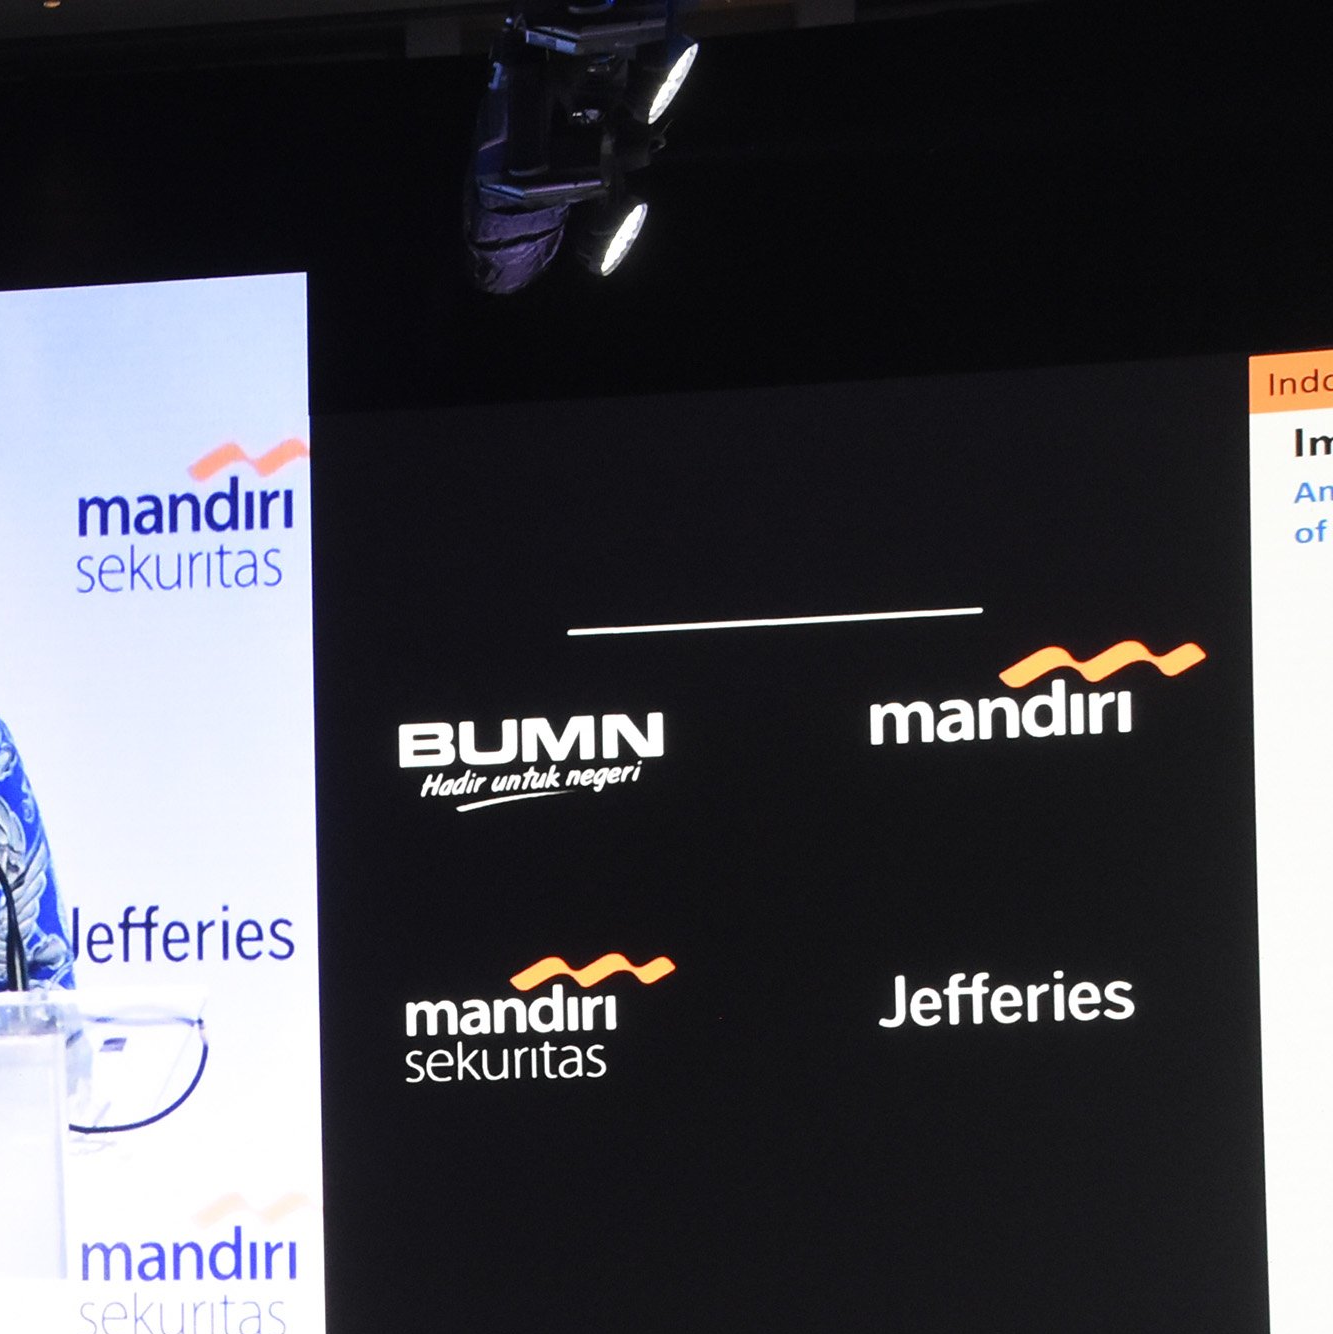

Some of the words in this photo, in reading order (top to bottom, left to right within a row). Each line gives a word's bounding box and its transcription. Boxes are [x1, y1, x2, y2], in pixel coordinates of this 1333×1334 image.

[78, 475, 293, 537] mandiri
[1294, 518, 1329, 544] of
[76, 544, 283, 594] sekuritas
[397, 711, 665, 769] BUMN
[869, 678, 1132, 746] mandiri
[419, 769, 488, 798] Hadir
[490, 764, 561, 793] untuk
[564, 759, 643, 794] negeri
[69, 904, 296, 965] Jefferies
[405, 980, 617, 1037] mandiri
[878, 970, 1136, 1028] Jefferies
[405, 1040, 607, 1083] sekuritas
[81, 1225, 297, 1282] mandiri
